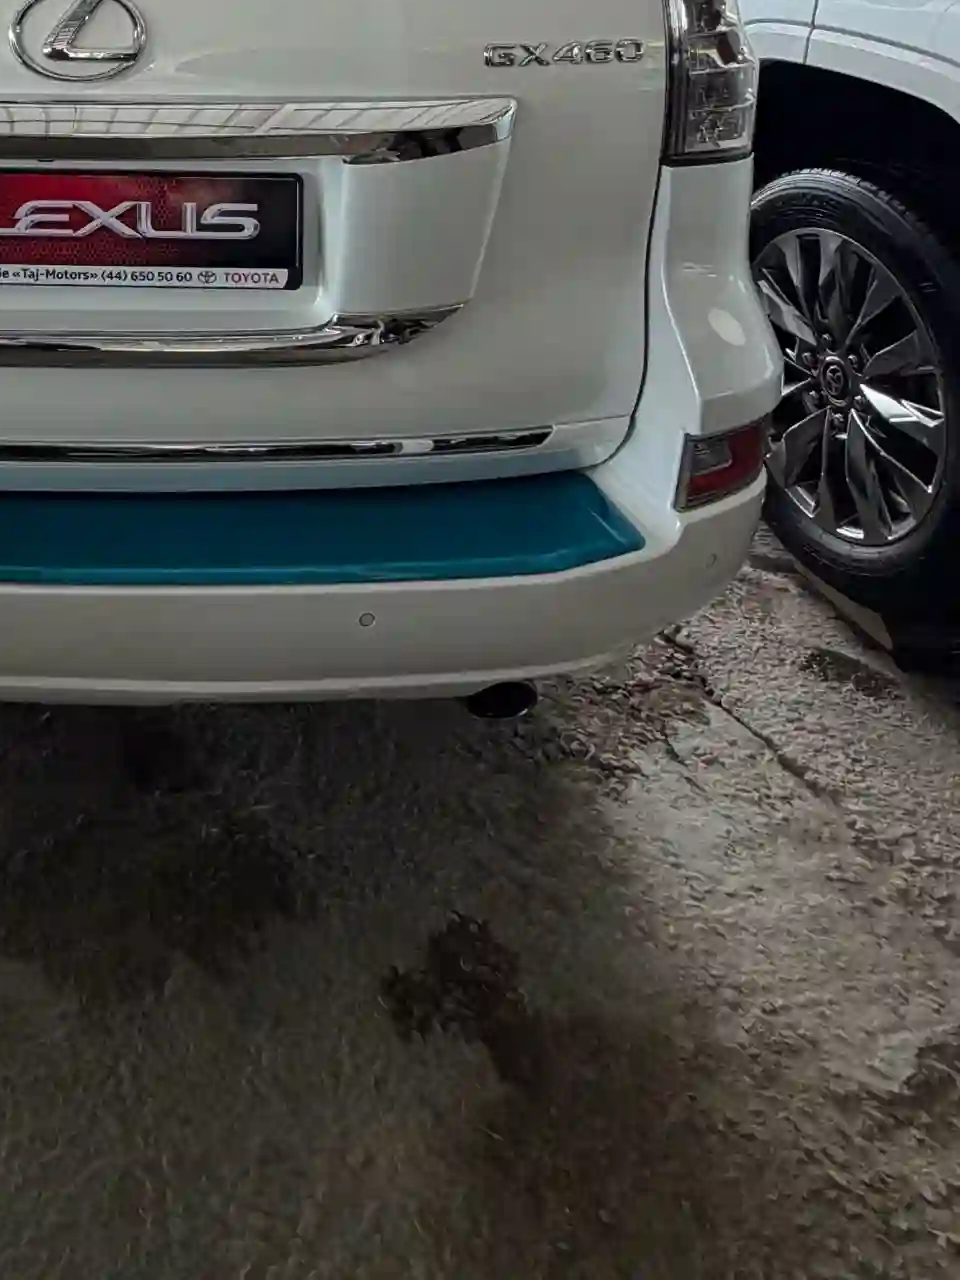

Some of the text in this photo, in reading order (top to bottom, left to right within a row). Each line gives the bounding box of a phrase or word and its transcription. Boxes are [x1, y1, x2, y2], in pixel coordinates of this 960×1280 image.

[483, 38, 645, 67] GX460
[100, 270, 128, 283] (44)
[130, 271, 155, 283] 650
[157, 271, 174, 283] 50
[175, 271, 193, 283] 60
[223, 271, 280, 285] TOYOTA
